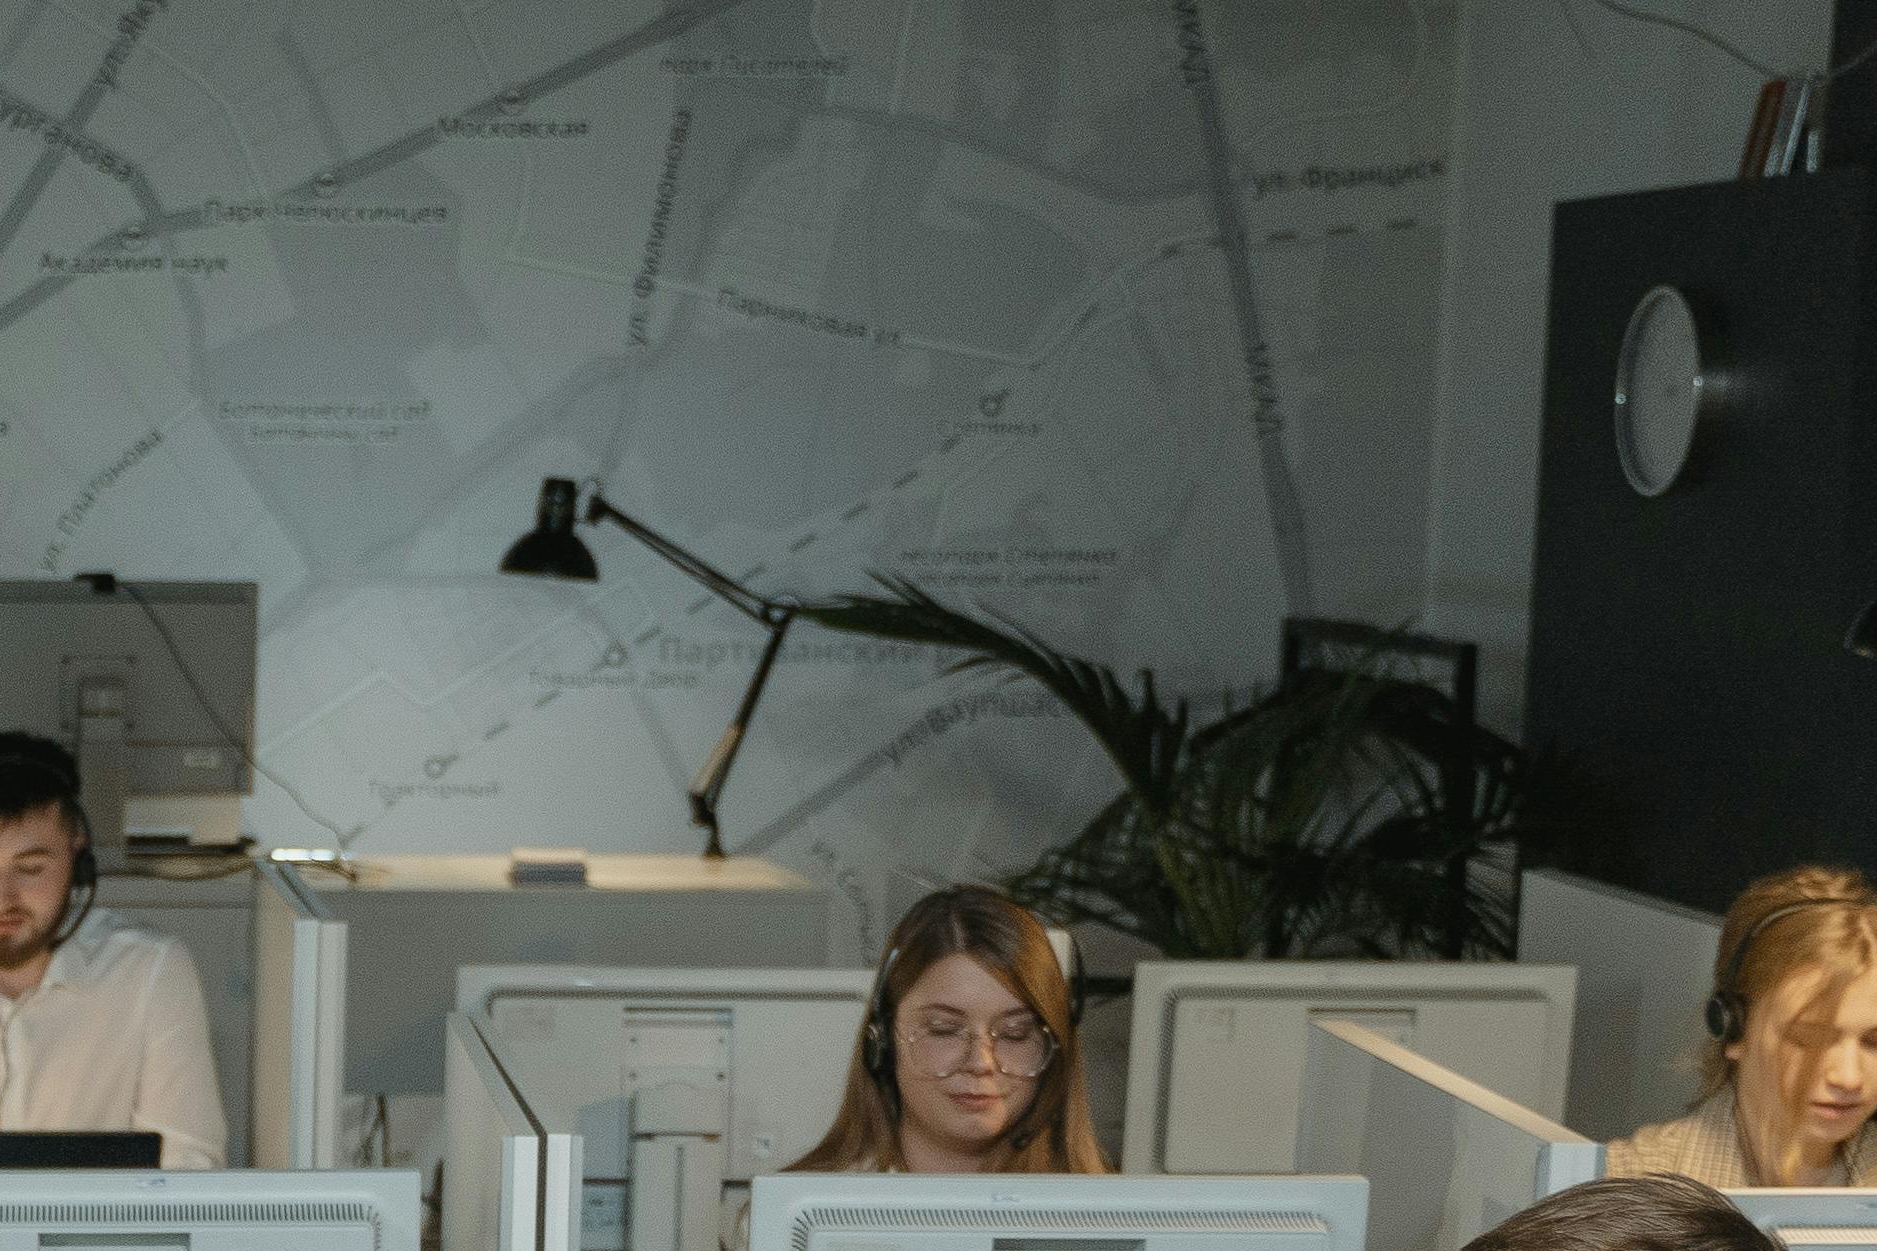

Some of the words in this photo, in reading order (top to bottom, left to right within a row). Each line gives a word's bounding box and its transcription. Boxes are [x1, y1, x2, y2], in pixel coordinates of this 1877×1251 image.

[438, 116, 590, 138] Московская
[633, 108, 693, 298] Филимонова
[40, 251, 163, 273] Академия
